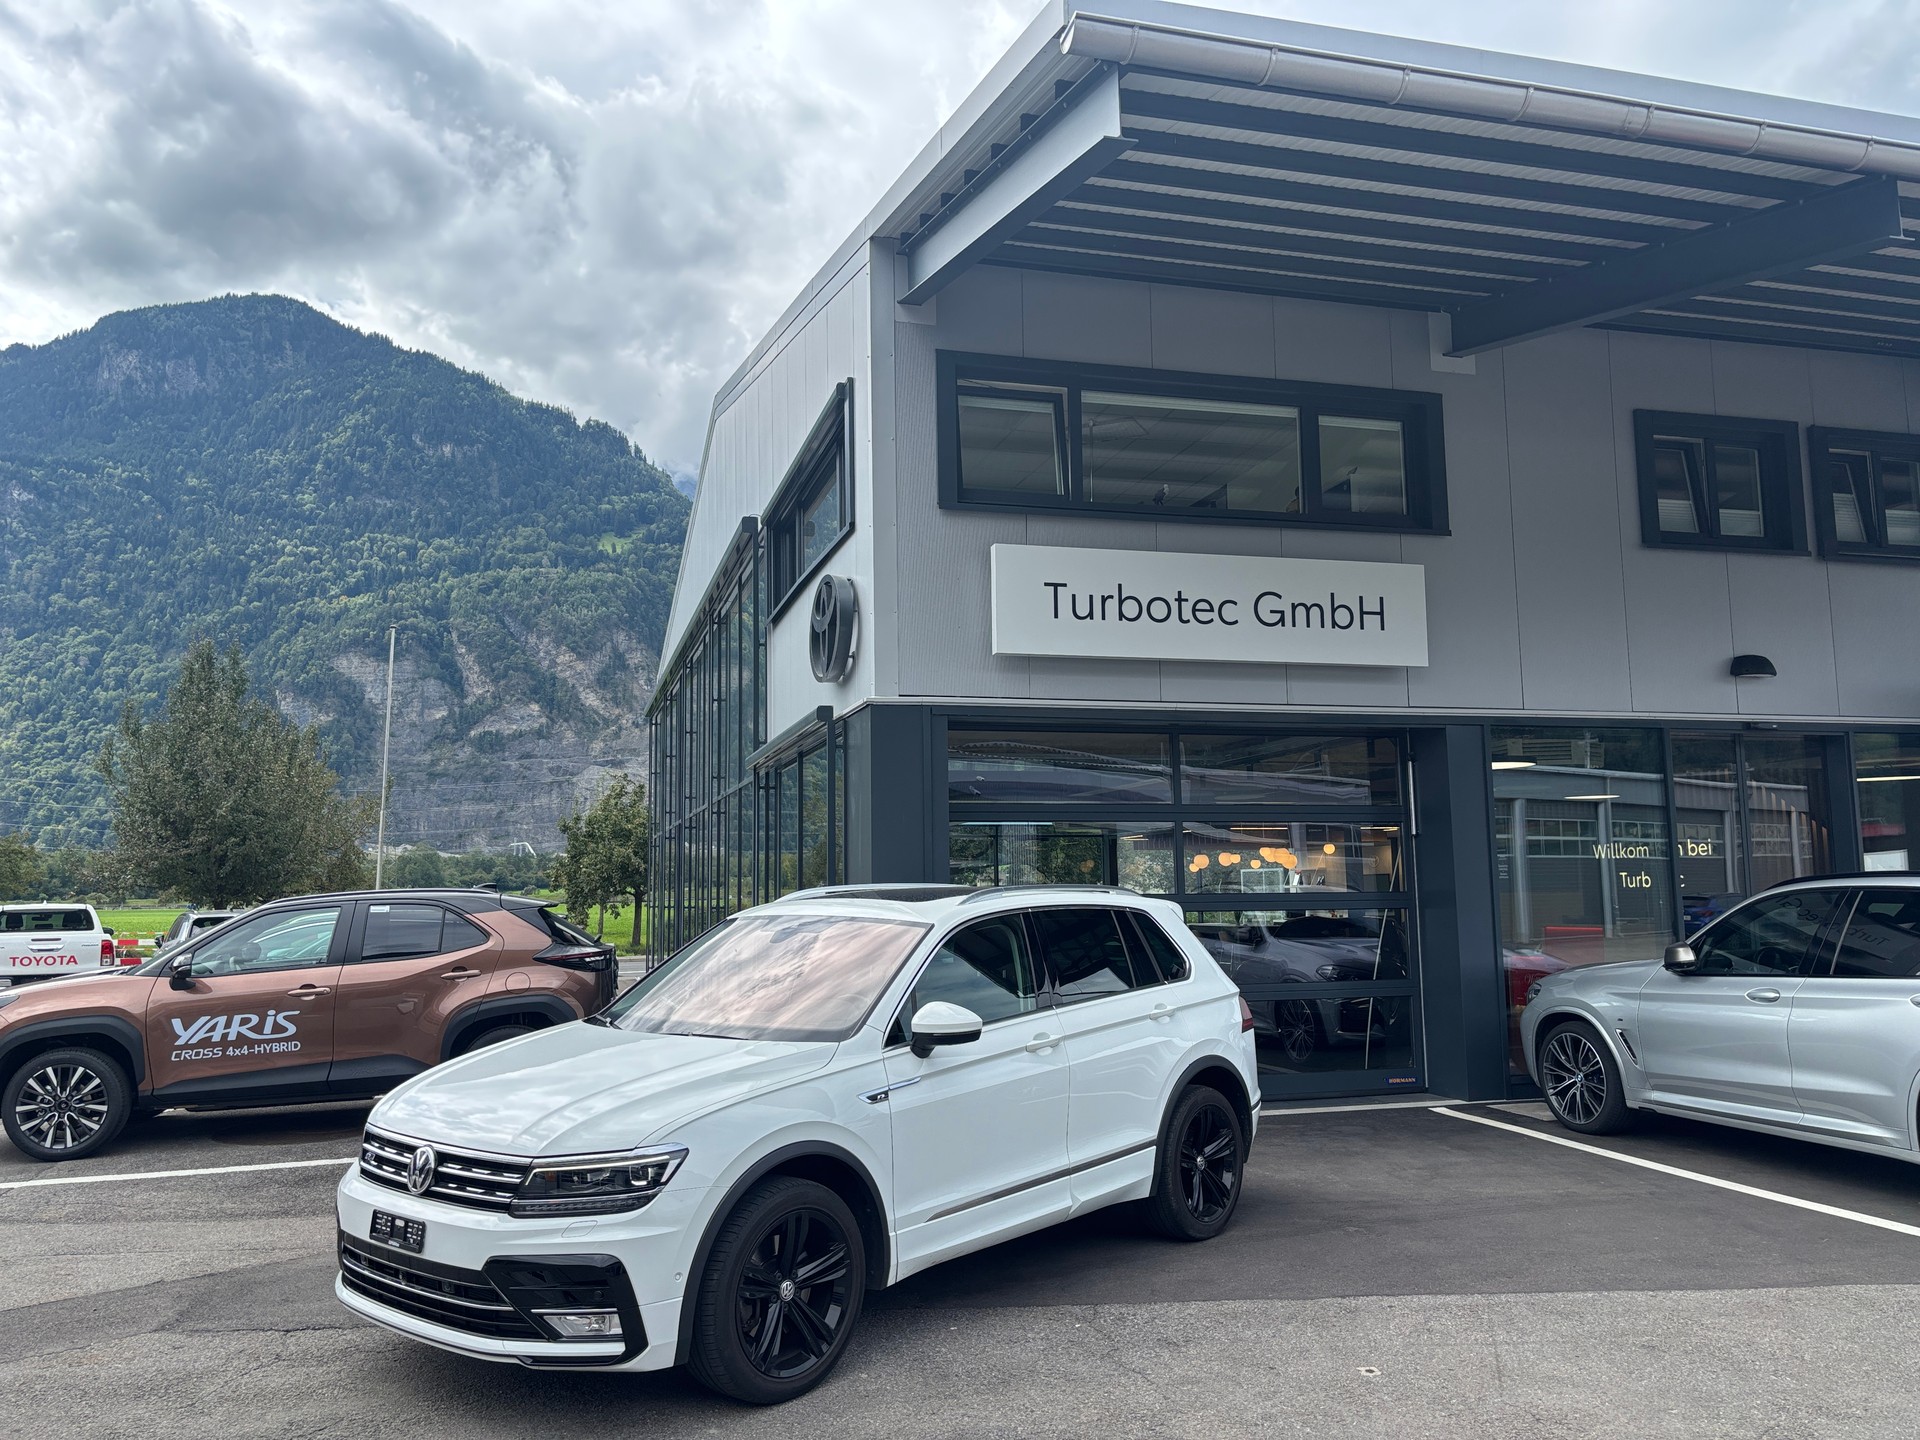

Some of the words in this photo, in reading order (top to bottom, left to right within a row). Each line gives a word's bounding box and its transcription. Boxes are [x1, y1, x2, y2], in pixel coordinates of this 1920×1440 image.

[1043, 581, 1239, 626] Turbotec
[1253, 590, 1386, 631] GmbH
[1687, 838, 1713, 856] bei
[9, 955, 78, 967] TOYOTA
[171, 1046, 223, 1061] CROSS
[226, 1041, 301, 1057] 4x4-HYBRID
